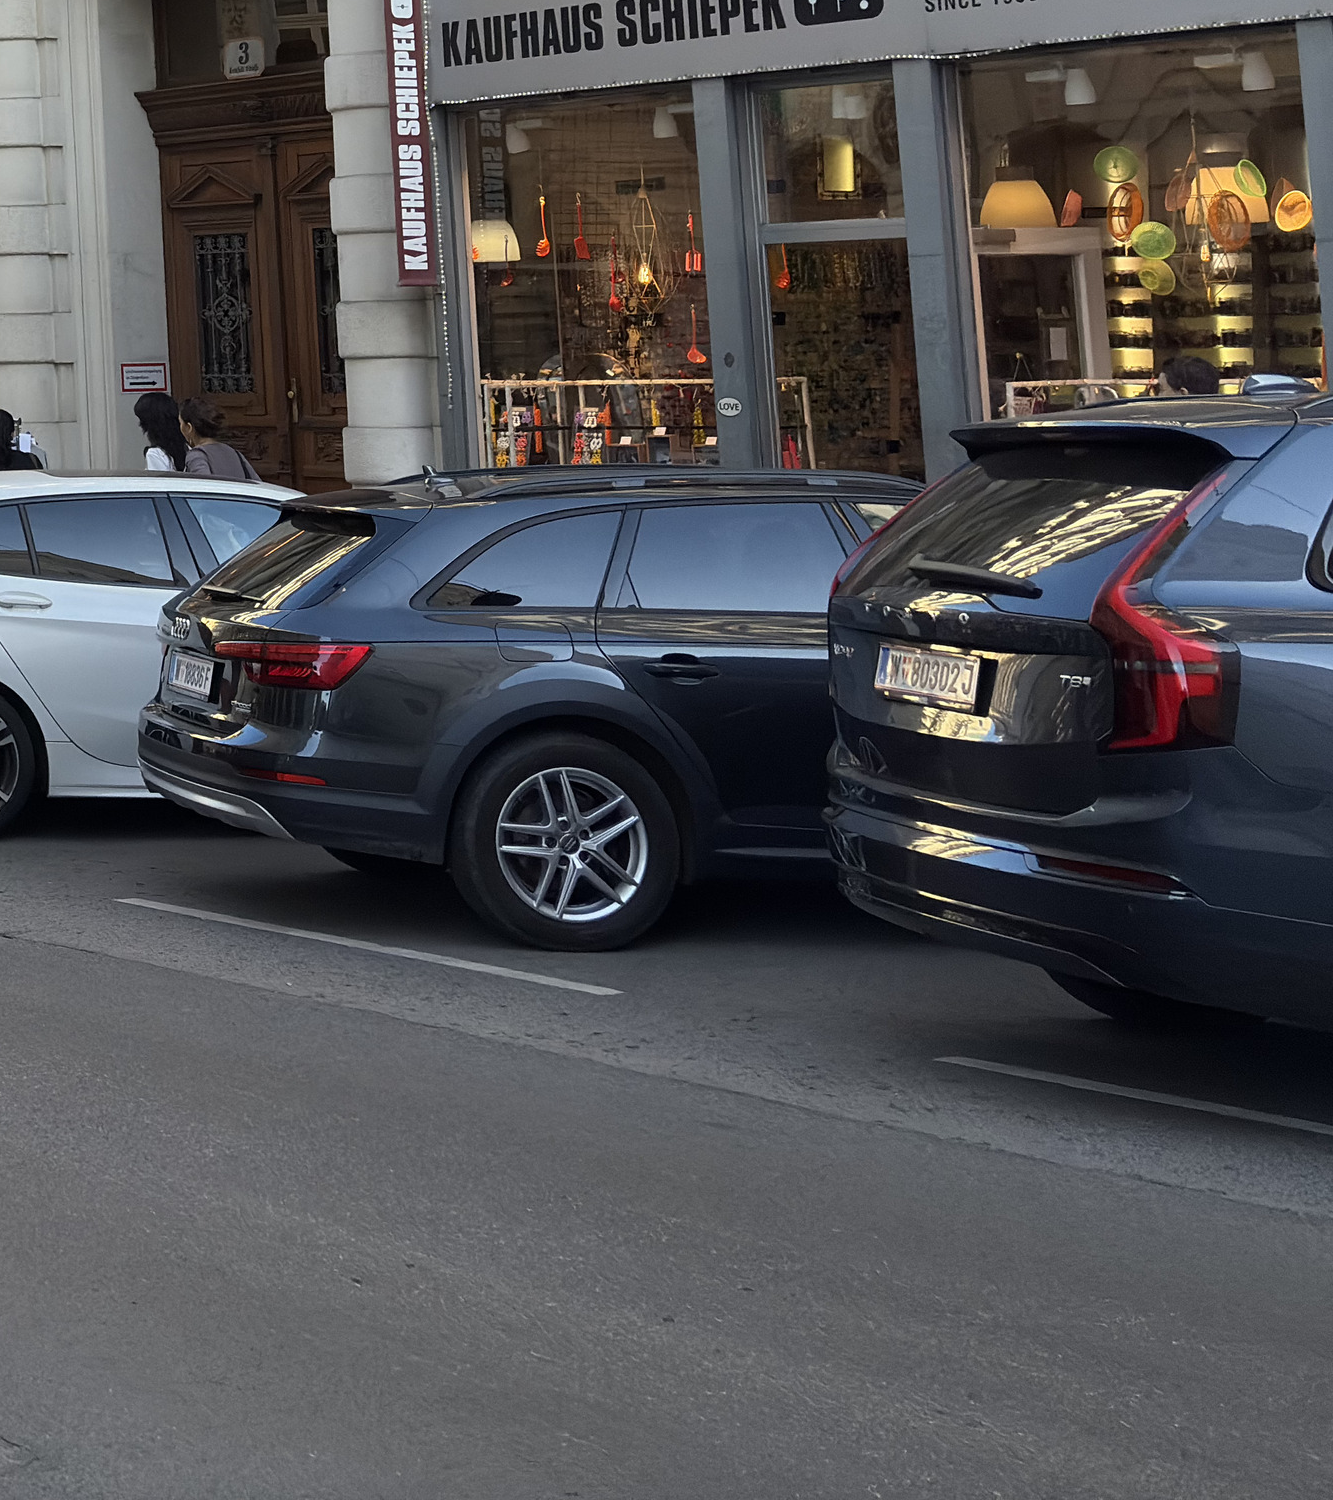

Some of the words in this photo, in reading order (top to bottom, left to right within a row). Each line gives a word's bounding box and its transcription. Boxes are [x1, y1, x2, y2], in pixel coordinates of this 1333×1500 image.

[238, 41, 250, 65] 3
[441, 1, 605, 68] KAUFHAUS
[392, 22, 421, 137] SCHIEPEK
[398, 143, 430, 271] KAUFHAUS
[718, 402, 741, 411] LOVE
